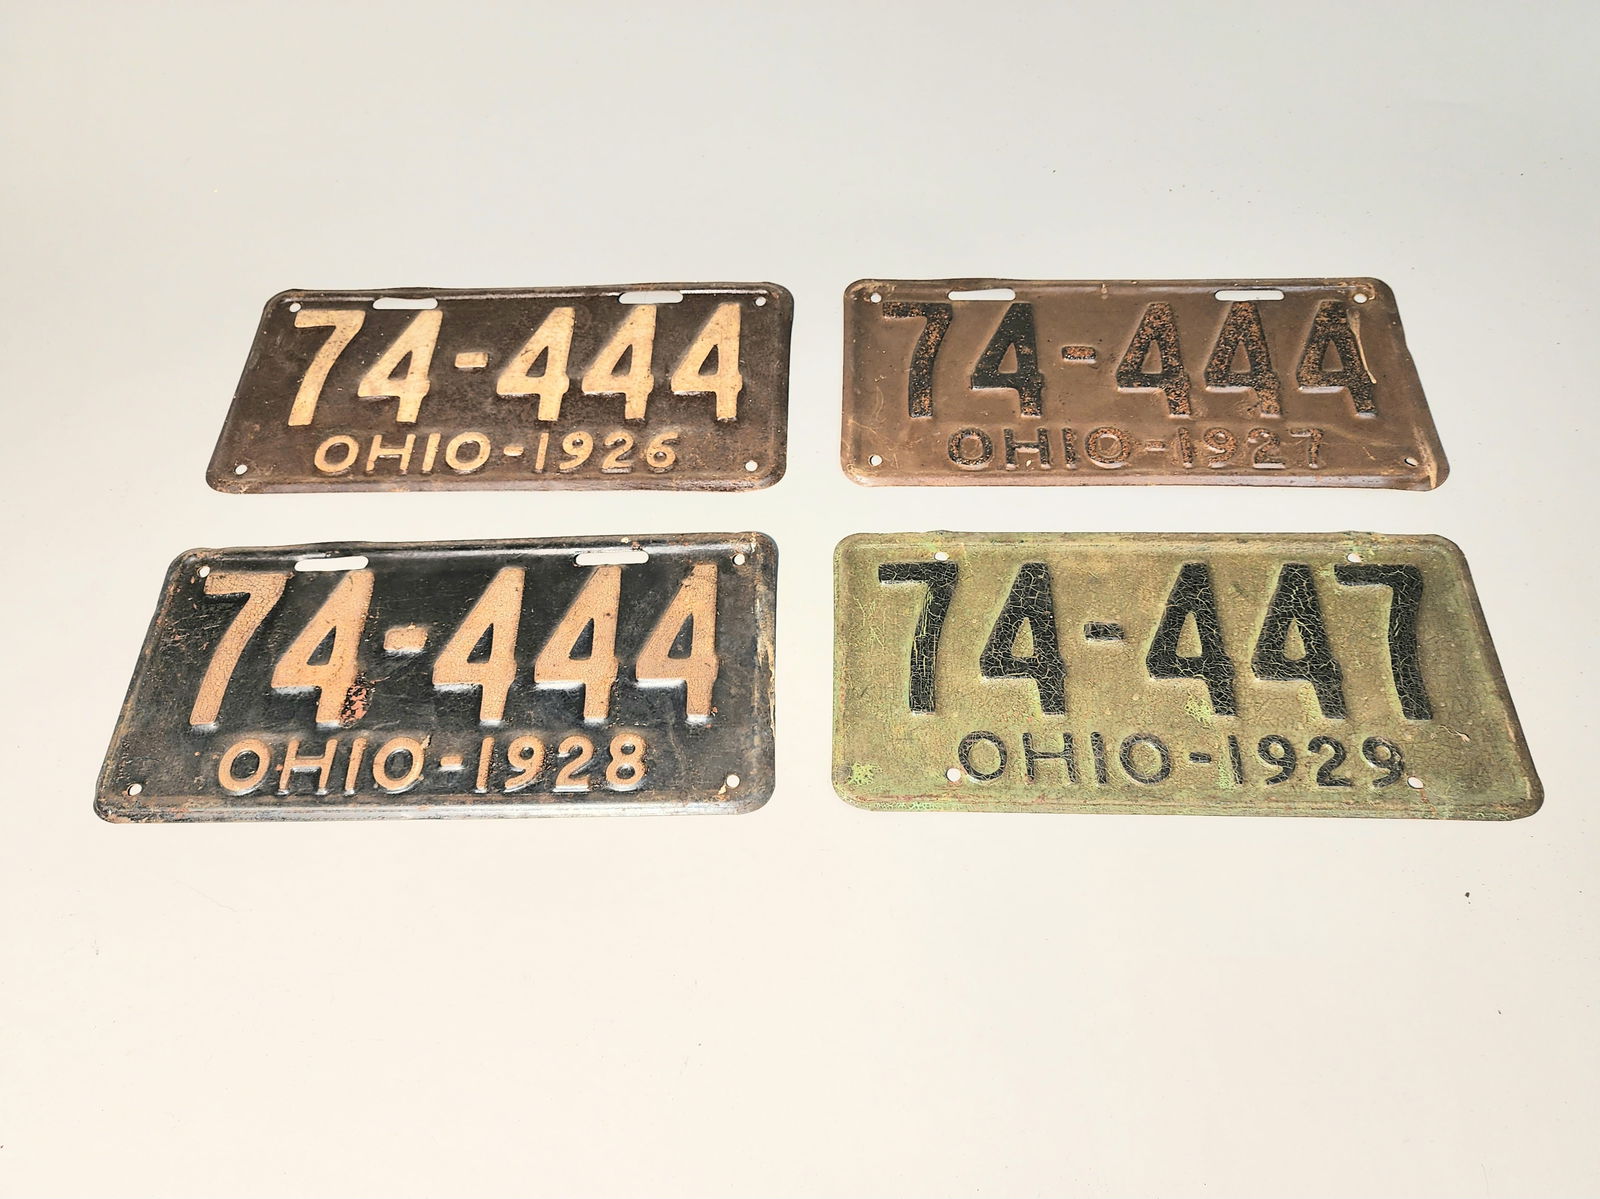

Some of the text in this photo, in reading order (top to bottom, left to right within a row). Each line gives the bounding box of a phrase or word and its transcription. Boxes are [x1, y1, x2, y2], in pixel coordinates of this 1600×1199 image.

[287, 303, 743, 426] 74-444
[882, 301, 1377, 418] 74-444
[190, 564, 718, 729] 74-444
[879, 562, 1431, 719] 74-447
